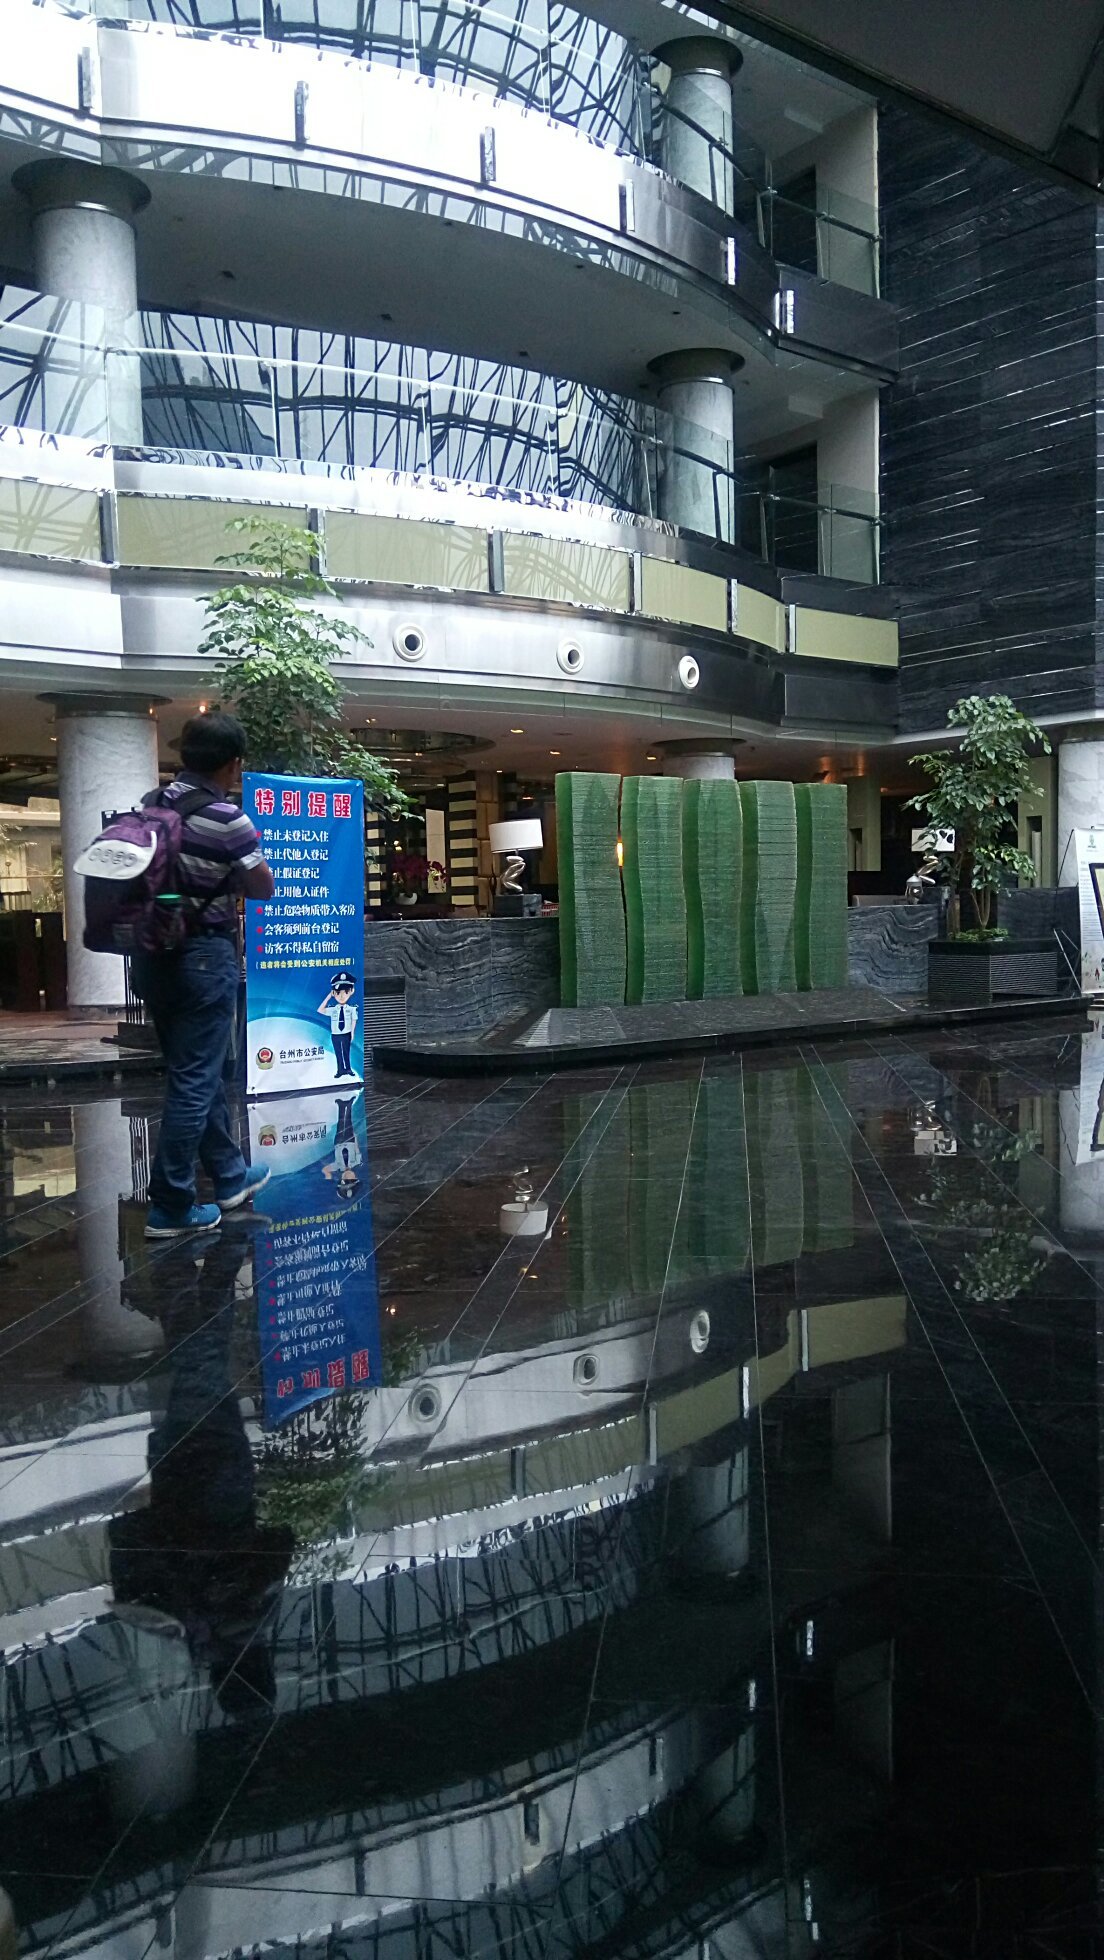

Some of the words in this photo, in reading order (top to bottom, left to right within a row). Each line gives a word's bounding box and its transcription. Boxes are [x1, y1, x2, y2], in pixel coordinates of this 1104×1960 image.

[255, 788, 352, 818] 特别提醒
[263, 829, 329, 842] 禁止未登记入住
[263, 847, 329, 861] 禁止代他人登记
[272, 886, 330, 898] 止用他人证件
[264, 904, 356, 916] 禁止危险物质带入客房
[264, 922, 340, 936] 会客须到前台登记
[264, 941, 340, 954] 访客不得私自留宿
[279, 1045, 325, 1059] 台州市公安局
